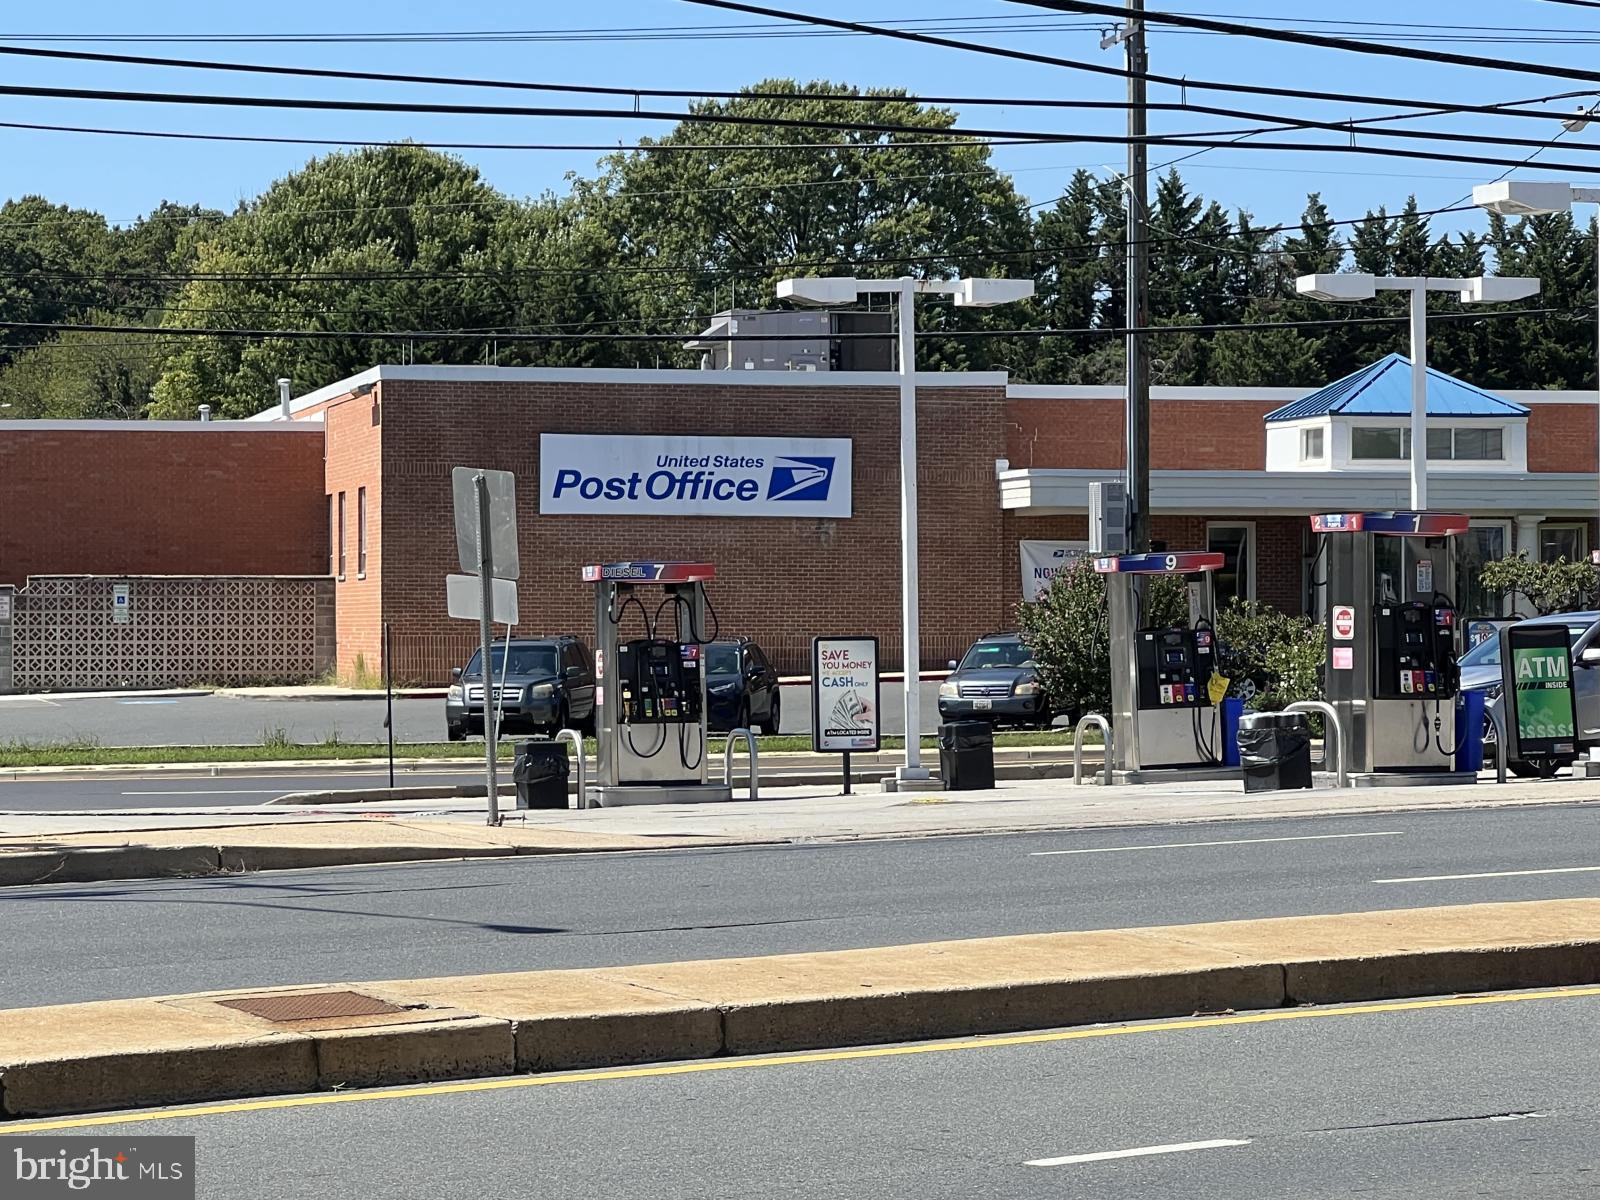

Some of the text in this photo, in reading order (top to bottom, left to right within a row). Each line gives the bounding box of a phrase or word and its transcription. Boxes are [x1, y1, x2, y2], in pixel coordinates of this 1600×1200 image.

[656, 455, 764, 468] United States
[552, 469, 759, 501] Post Office
[1314, 516, 1321, 529] 2
[1412, 514, 1420, 533] 1
[1165, 554, 1177, 571] 9
[602, 567, 646, 577] DIESEL
[653, 564, 665, 580] 7
[822, 650, 849, 660] SAVE
[822, 661, 872, 669] YOU MONEY
[1518, 656, 1566, 678] ATM
[822, 677, 853, 687] CASH
[1545, 681, 1568, 689] INSIDE
